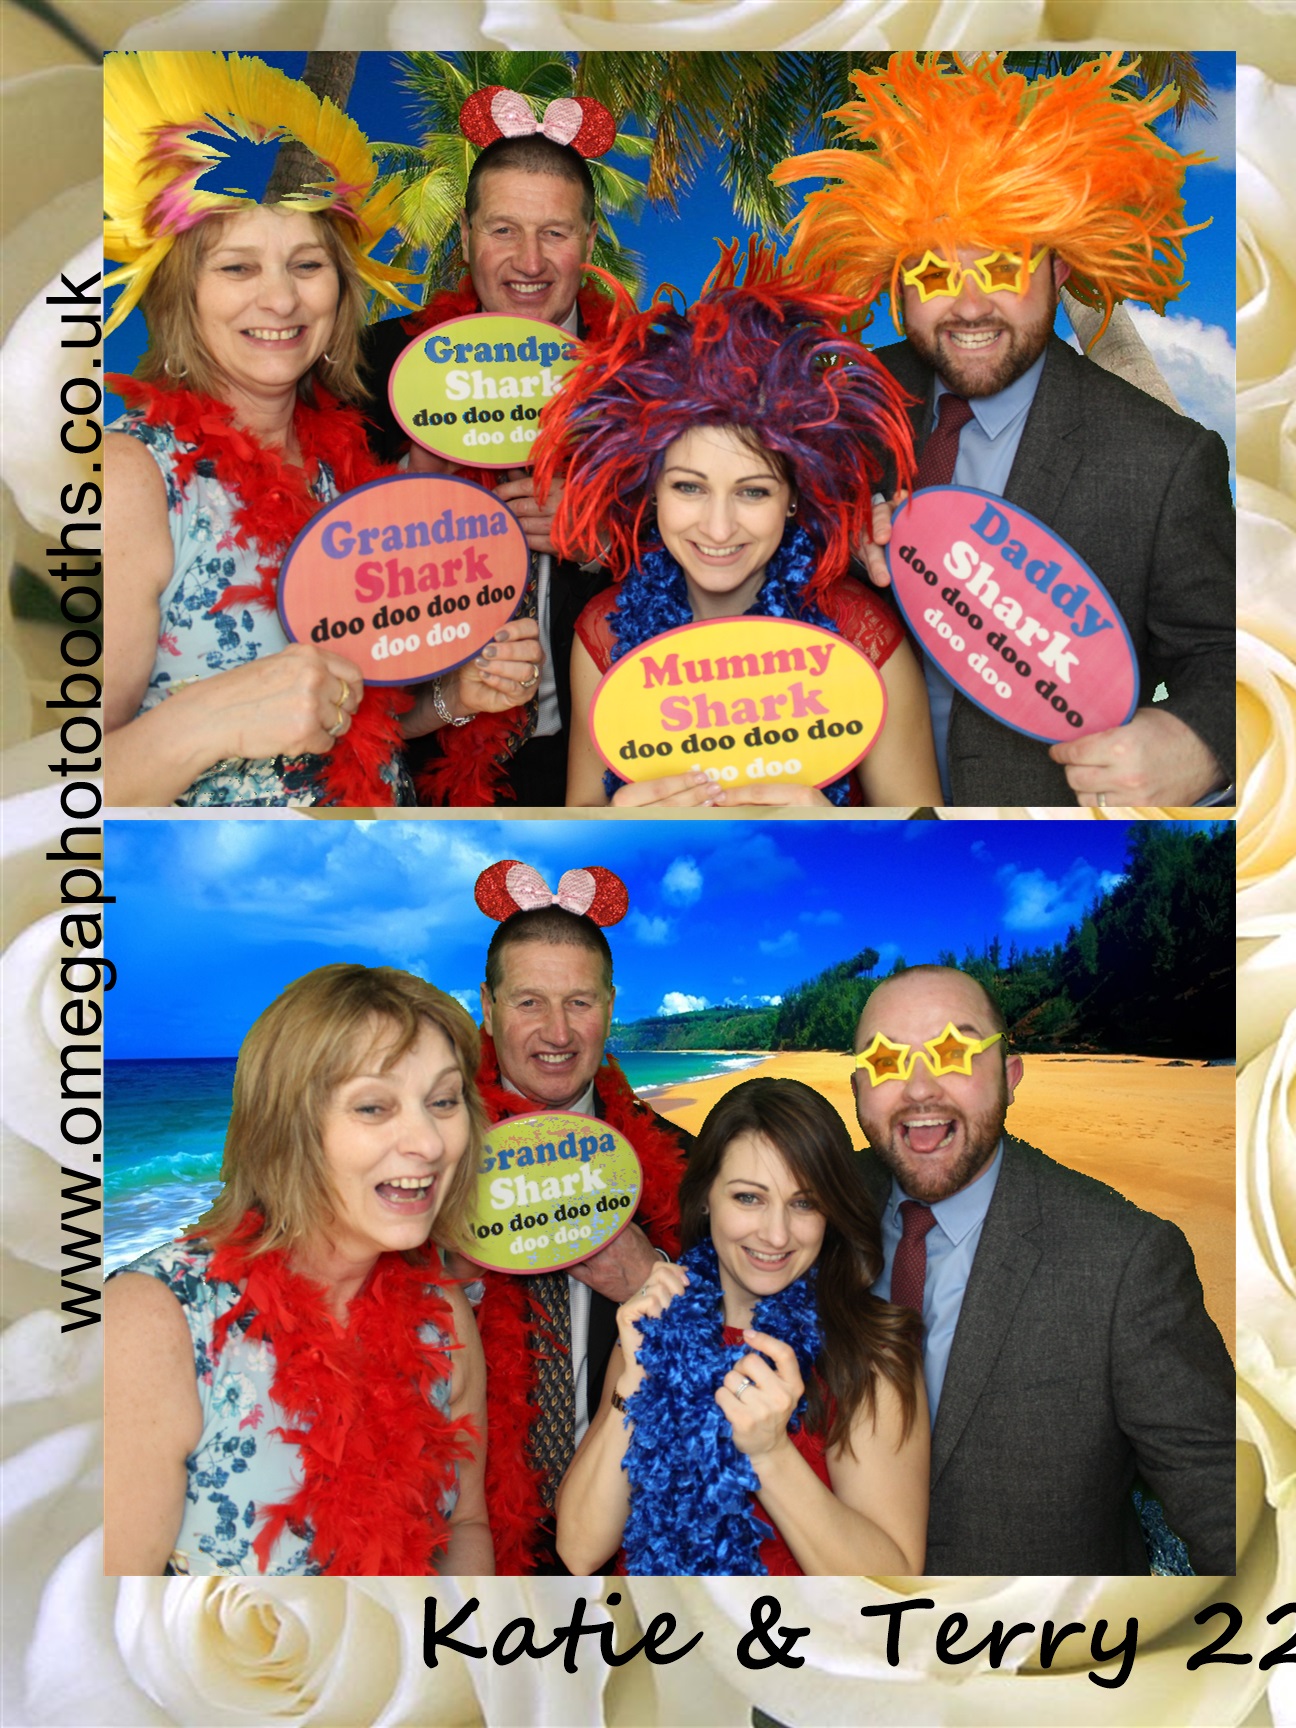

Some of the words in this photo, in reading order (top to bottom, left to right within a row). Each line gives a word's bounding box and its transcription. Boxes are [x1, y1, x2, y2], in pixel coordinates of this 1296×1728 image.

[445, 368, 566, 400] Shark
[412, 409, 457, 427] doo
[462, 407, 504, 424] doo
[510, 404, 545, 421] do
[462, 429, 504, 446] doo
[510, 426, 543, 443] do
[321, 509, 509, 559] Grandma
[354, 546, 493, 603] Shark
[969, 501, 1114, 638] Daddy
[311, 617, 364, 643] doo
[372, 606, 420, 629] doo
[427, 595, 470, 617] doo
[476, 585, 515, 606] doo
[943, 541, 1079, 684] Shark
[371, 635, 420, 661] doo
[426, 622, 470, 647] doo
[898, 545, 938, 586] doo
[941, 587, 983, 630] doo
[986, 631, 1032, 677] doo
[1035, 679, 1084, 728] doo
[923, 608, 965, 652] doo
[967, 652, 1012, 699] doo
[639, 643, 836, 688] Mummy
[660, 681, 830, 732] Shark
[619, 740, 673, 760] doo
[681, 734, 735, 754] doo
[744, 727, 799, 747] doo
[807, 719, 863, 740] doo
[690, 763, 739, 782] oo
[746, 756, 802, 779] doo
[490, 1162, 607, 1210] Shark
[510, 1213, 549, 1232] doo
[554, 1204, 591, 1222] doo
[596, 1195, 631, 1213] doo
[510, 1236, 549, 1255] doo
[554, 1225, 592, 1244] doo
